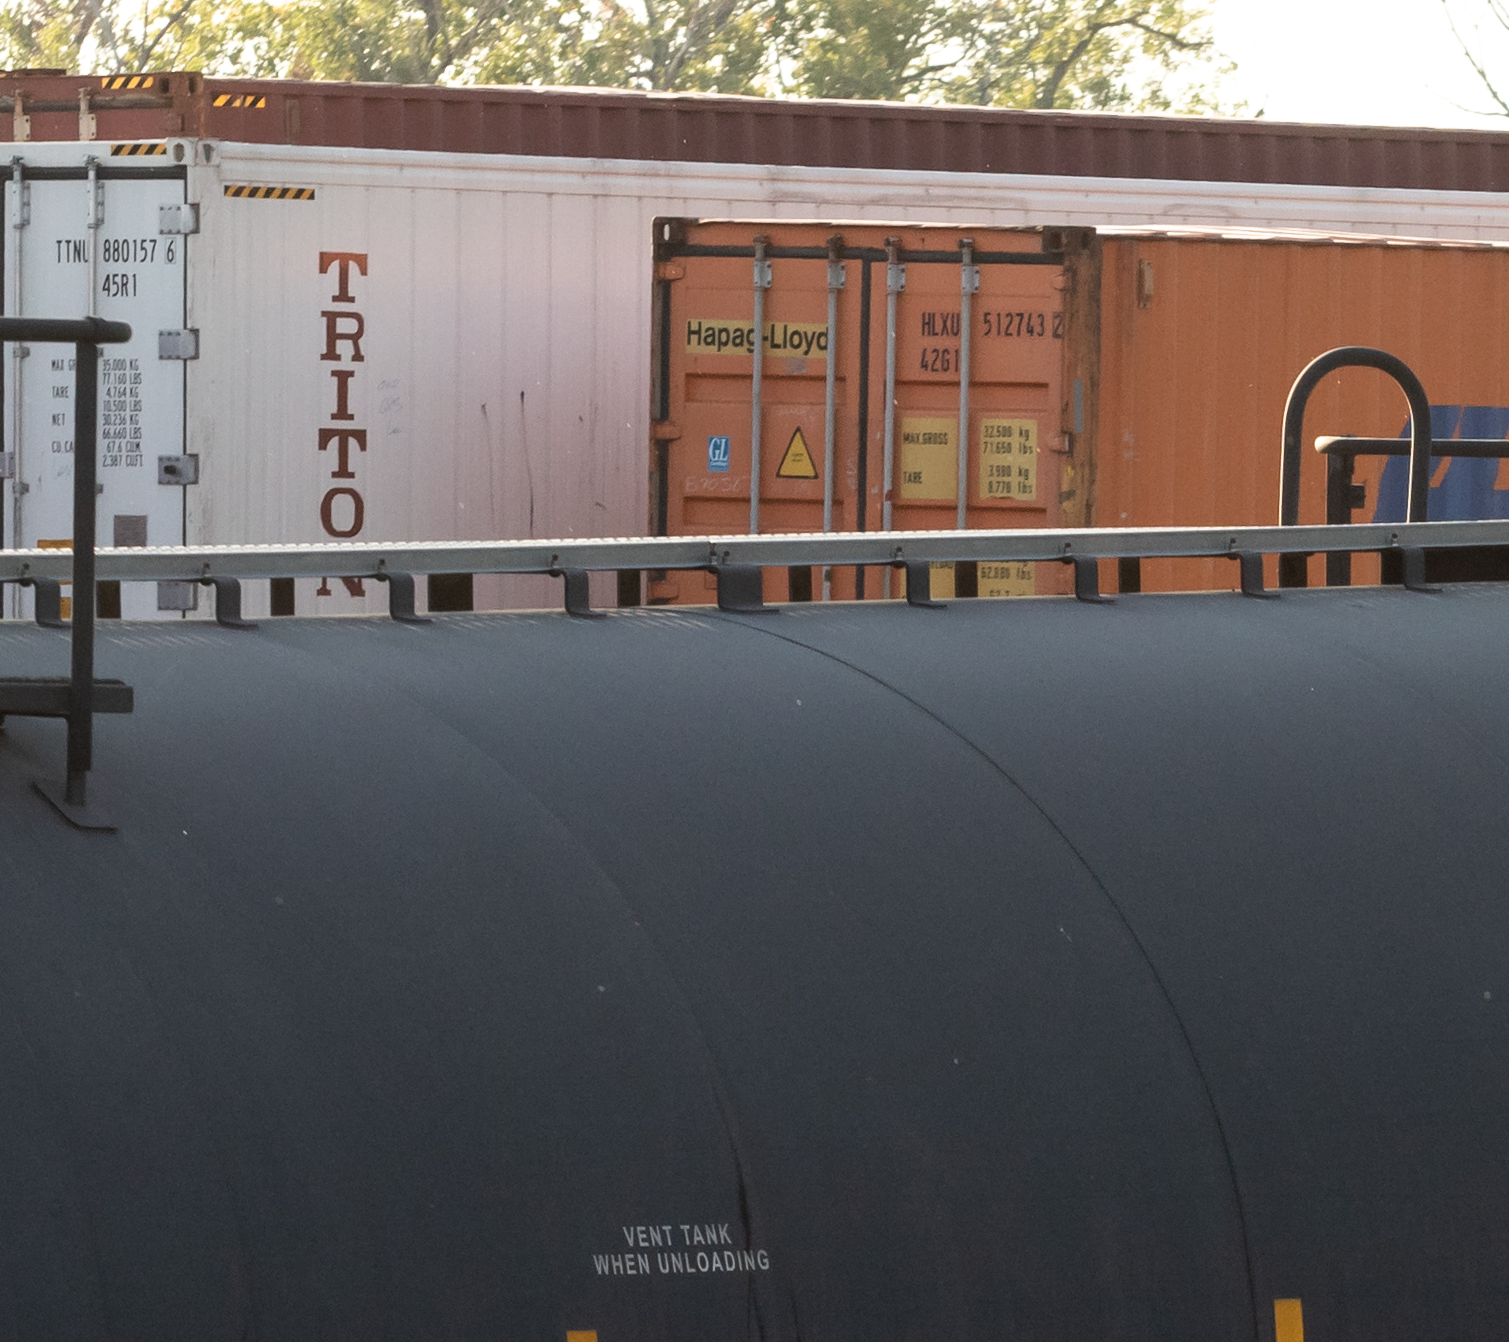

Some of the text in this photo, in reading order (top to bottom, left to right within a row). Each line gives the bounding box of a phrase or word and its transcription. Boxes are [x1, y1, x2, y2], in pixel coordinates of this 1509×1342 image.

[102, 240, 157, 263] 880157
[166, 240, 174, 262] 6
[102, 274, 137, 297] 45R1
[921, 312, 958, 336] HLXU
[982, 313, 1043, 337] 512743
[709, 437, 729, 462] GL
[623, 1224, 732, 1248] VENT TANK
[593, 1250, 770, 1276] WHEN UNLOADING
